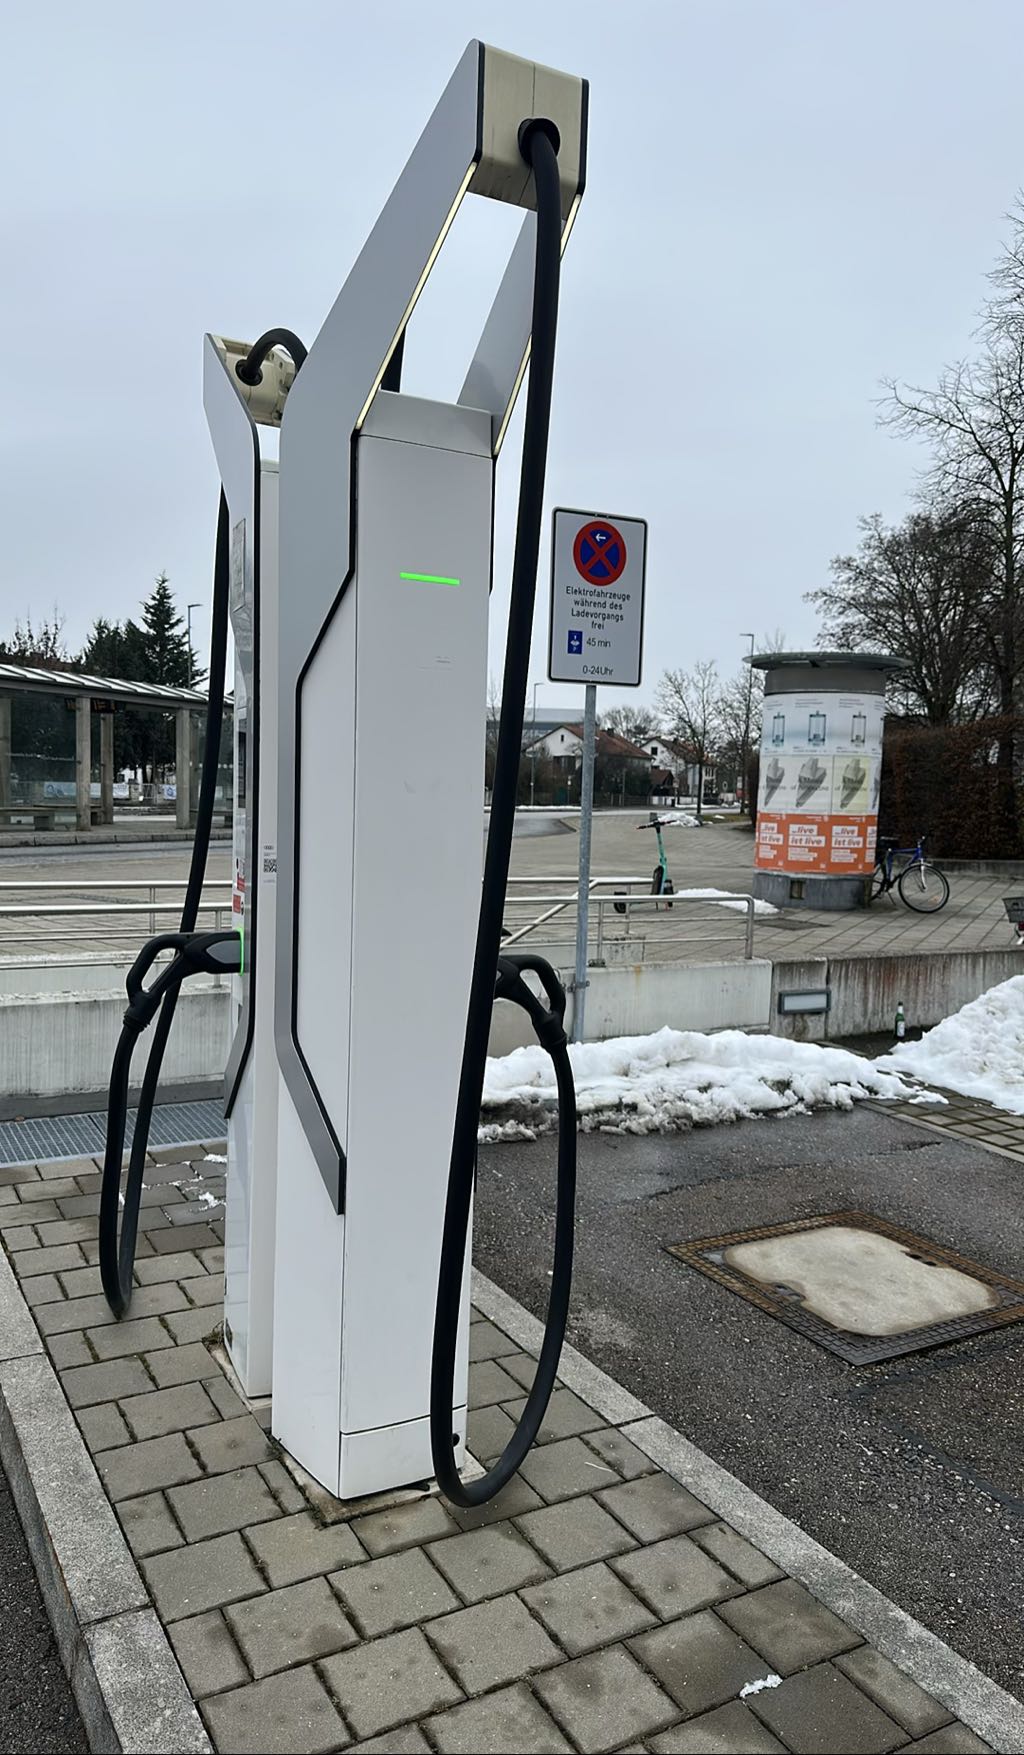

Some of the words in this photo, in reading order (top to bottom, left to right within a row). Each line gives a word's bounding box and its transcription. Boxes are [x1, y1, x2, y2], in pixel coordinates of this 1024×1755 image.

[565, 586, 631, 602] Elektrofahrzeuge
[573, 598, 607, 609] während
[609, 601, 623, 610] des
[571, 608, 624, 623] Ladevorgangs
[591, 620, 605, 630] frei
[586, 637, 597, 647] 45
[597, 639, 611, 648] min
[791, 836, 802, 844] ist
[805, 837, 822, 845] live
